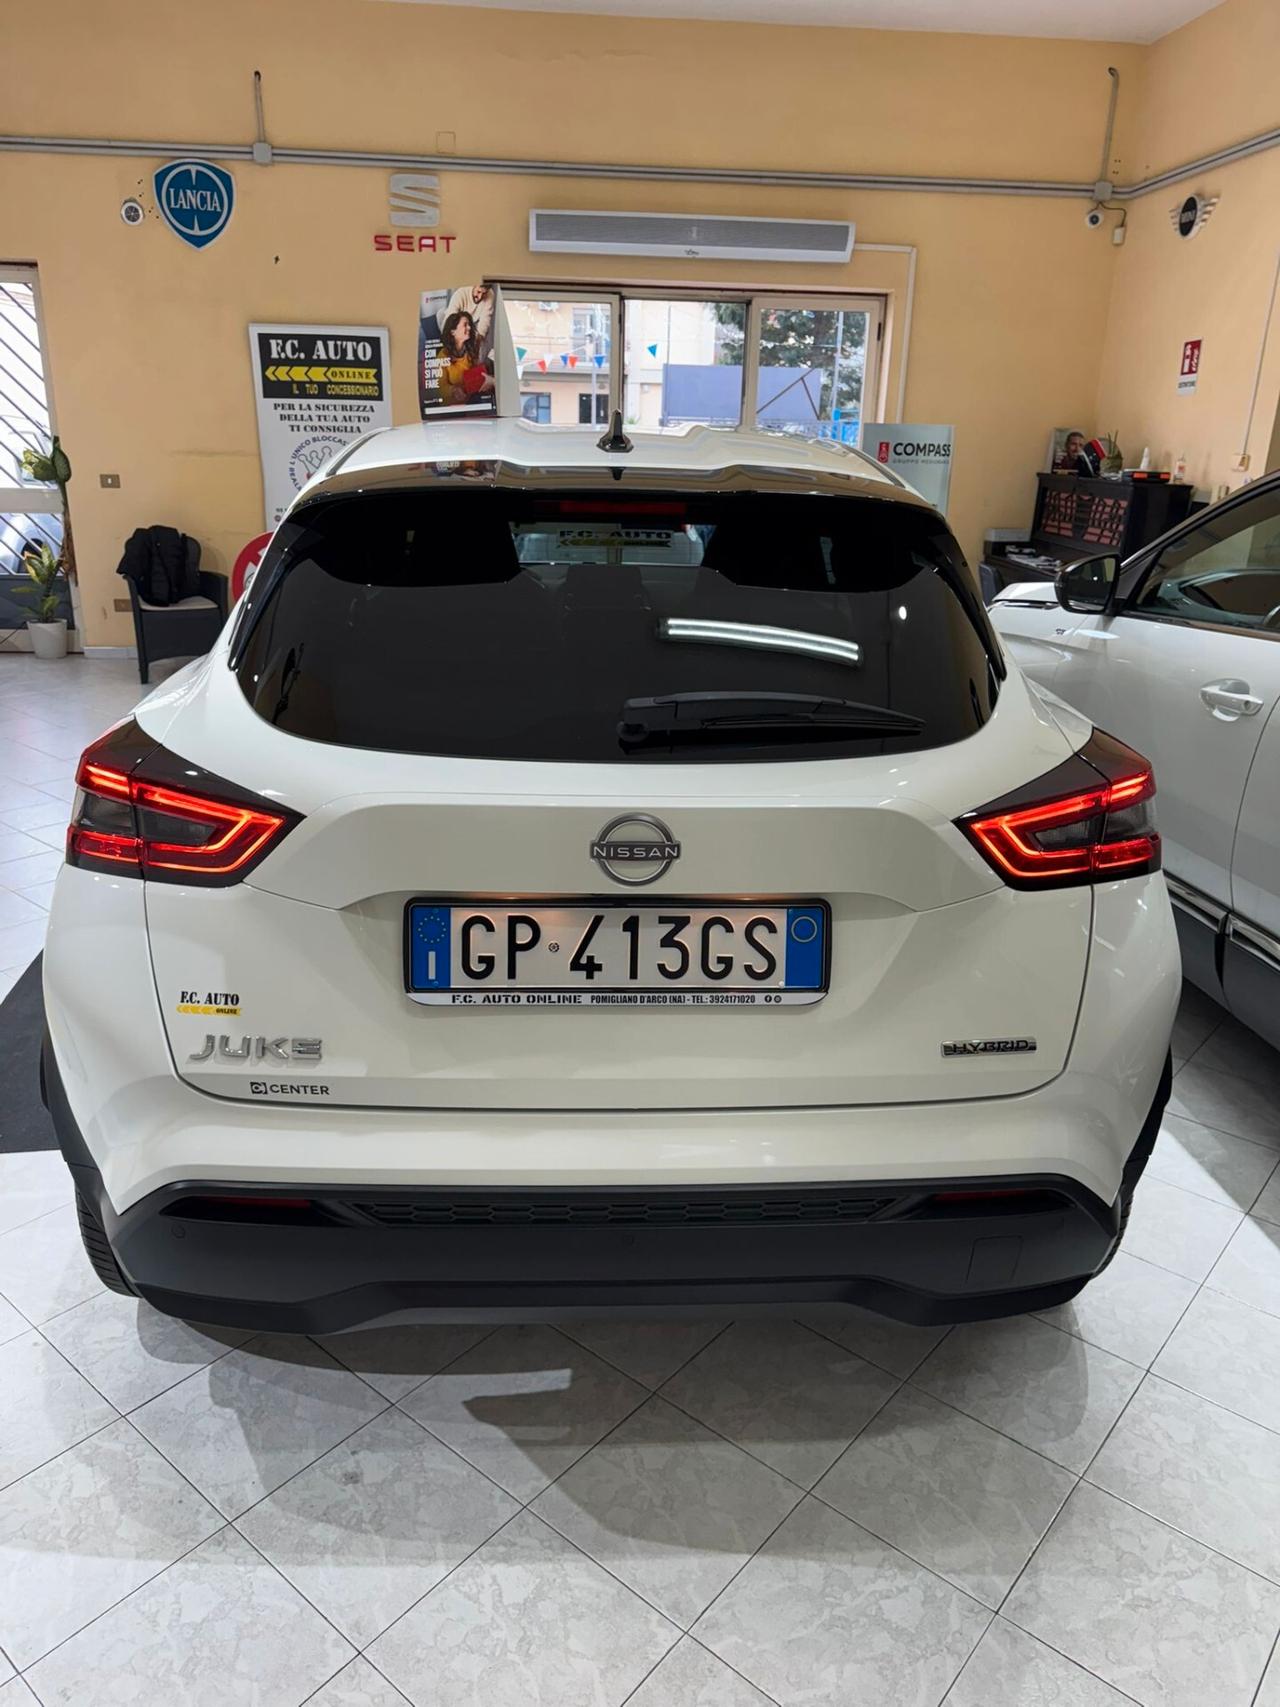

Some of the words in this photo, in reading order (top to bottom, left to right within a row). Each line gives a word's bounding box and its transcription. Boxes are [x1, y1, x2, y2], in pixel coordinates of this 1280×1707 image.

[169, 188, 221, 212] LANCIA
[374, 234, 457, 254] SEAT
[269, 339, 306, 360] F.C.
[312, 340, 373, 361] AUTO
[331, 372, 371, 380] ONLINE
[292, 384, 299, 394] IL
[306, 384, 319, 394] TUO
[327, 385, 379, 396] CONCESSIONARIO
[274, 403, 296, 411] PER
[315, 404, 375, 413] SICUREZZA
[280, 414, 313, 422] DELLA
[316, 415, 338, 423] TUA
[341, 415, 370, 423] AUTO
[303, 425, 361, 434] CONSIGLIA
[893, 442, 951, 458] COMPASS
[609, 530, 672, 540] AUTO
[593, 846, 678, 858] NISSAN
[180, 991, 201, 1004] F.C.
[204, 992, 240, 1006] AUTO
[451, 994, 476, 1004] F.C.
[482, 994, 522, 1004] AUTO
[526, 994, 583, 1004] ONLINE
[590, 995, 638, 1004] POMIGLIANO
[639, 995, 668, 1004] D'ARCO
[669, 995, 686, 1004] (NA)
[189, 1034, 323, 1061] JUKE
[952, 1040, 1029, 1053] HYBRID
[269, 1084, 330, 1095] CENTER
